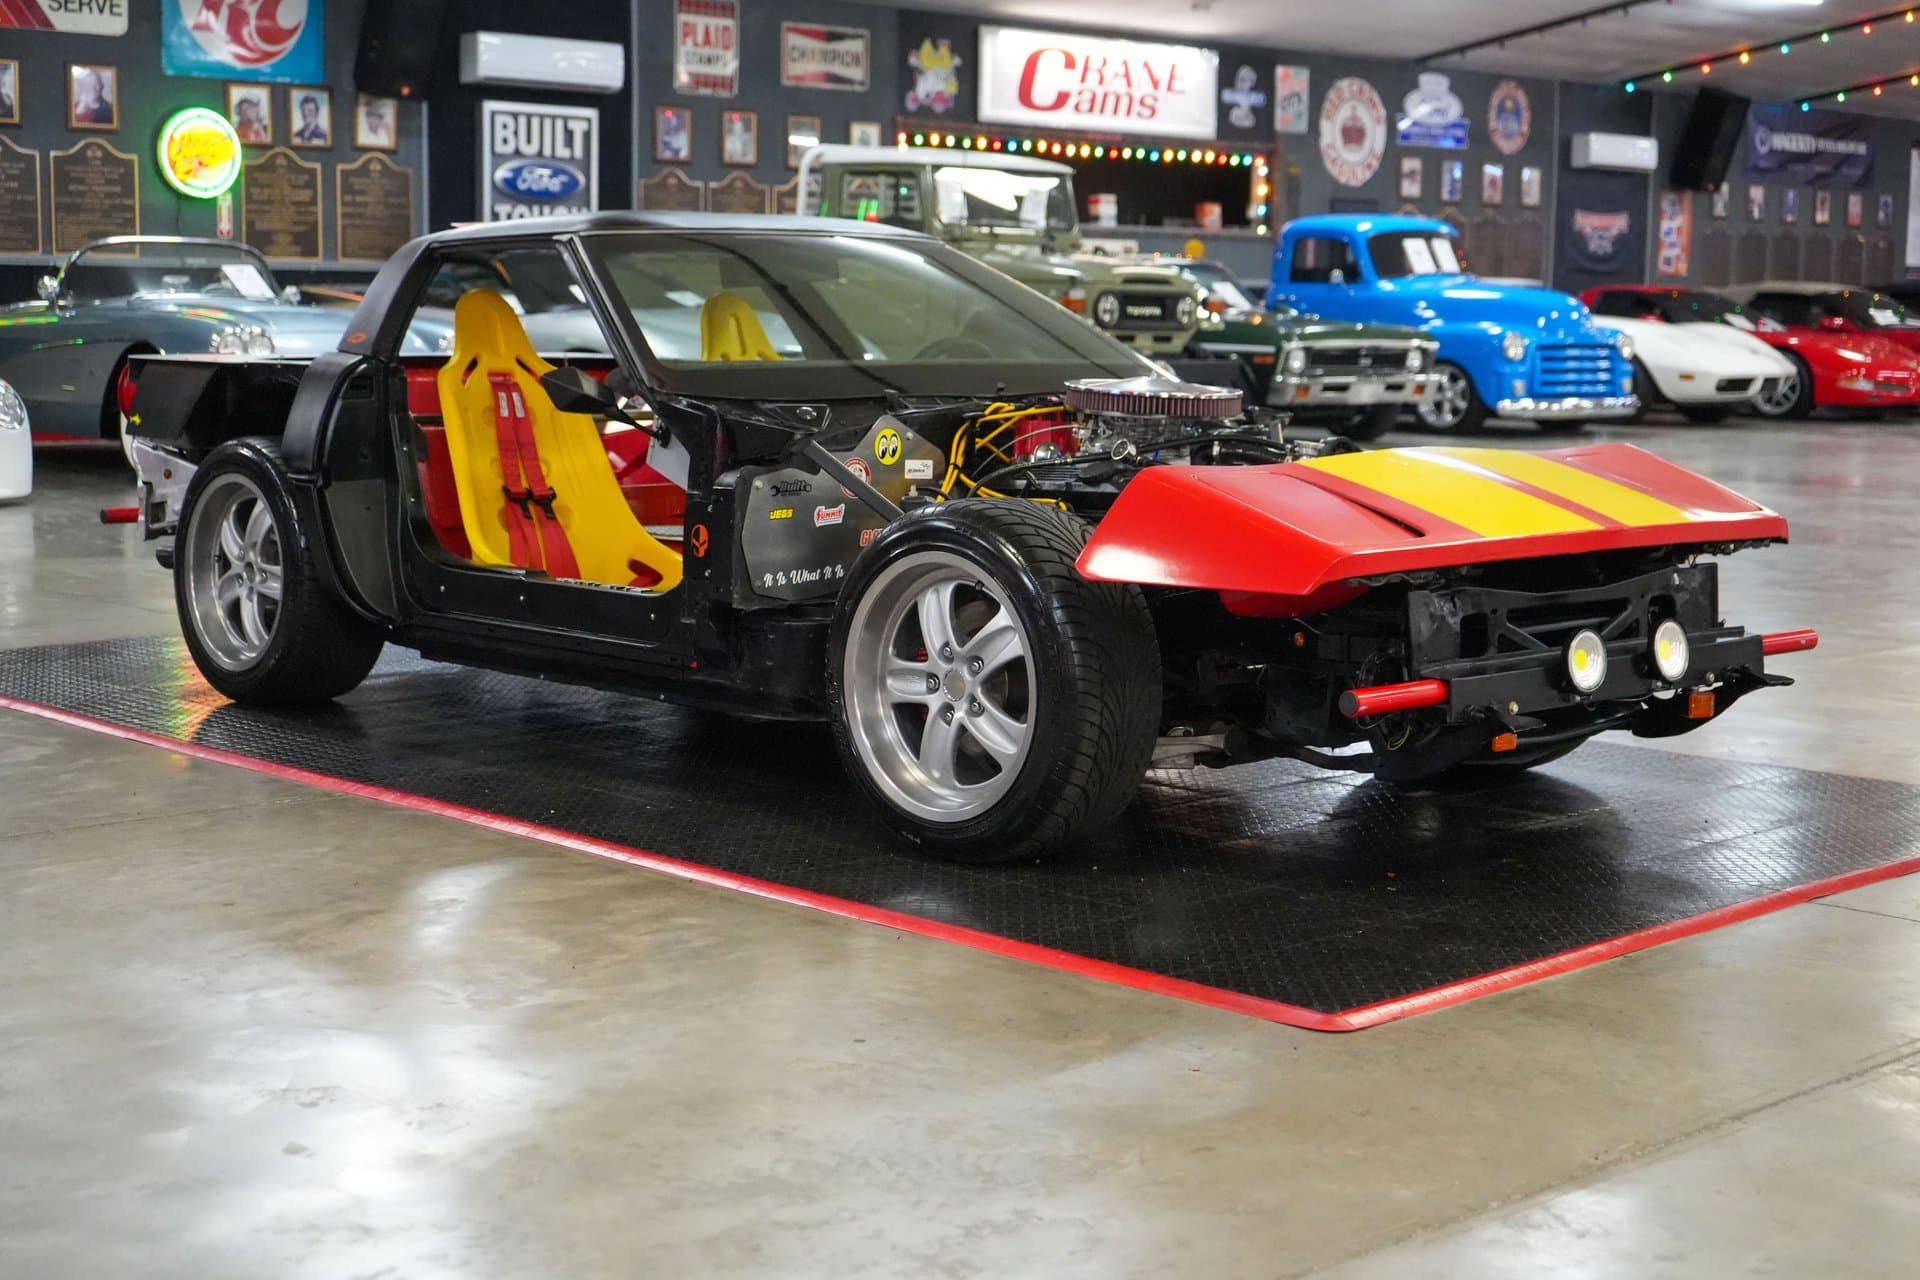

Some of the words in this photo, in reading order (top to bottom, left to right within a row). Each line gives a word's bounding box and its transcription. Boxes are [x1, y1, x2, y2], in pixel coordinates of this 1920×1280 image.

[48, 0, 122, 16] SERVE
[682, 21, 733, 51] PLAID
[493, 113, 589, 159] BUILT
[516, 165, 569, 193] Ford
[769, 508, 794, 520] JEGS
[764, 573, 774, 588] It
[777, 571, 786, 586] Is
[790, 568, 821, 584] What
[824, 566, 833, 580] It
[835, 564, 845, 579] Is
